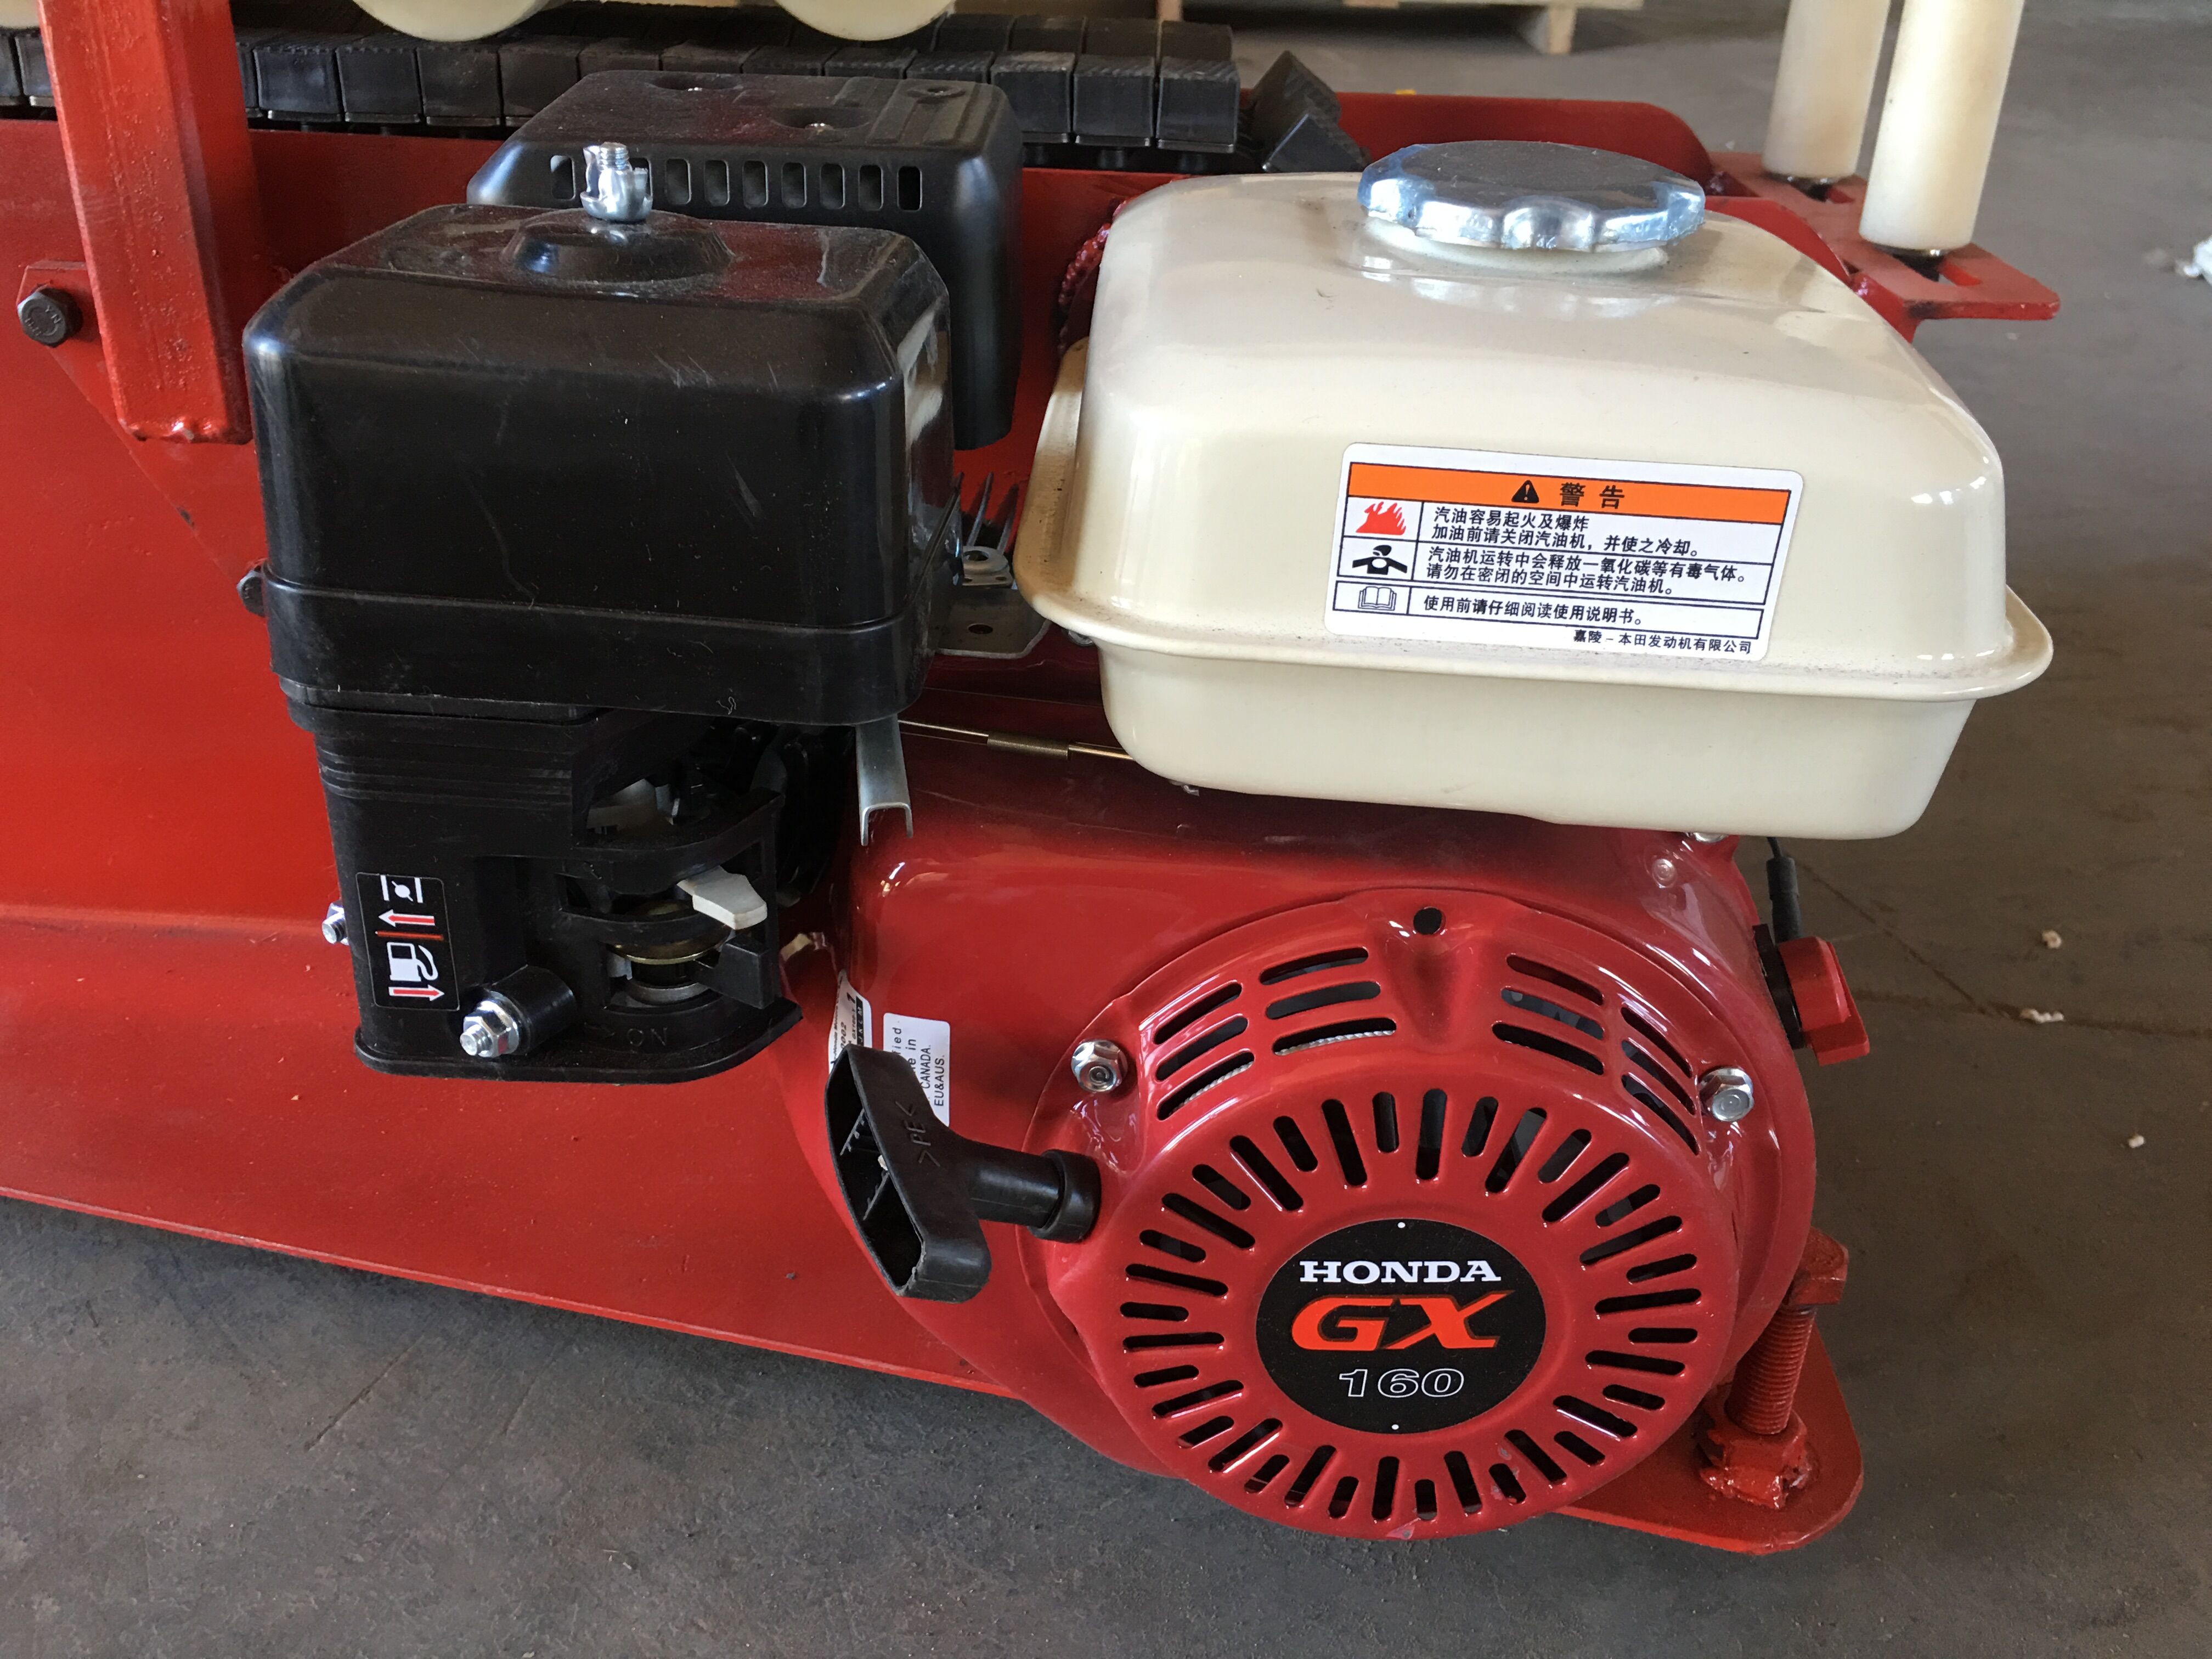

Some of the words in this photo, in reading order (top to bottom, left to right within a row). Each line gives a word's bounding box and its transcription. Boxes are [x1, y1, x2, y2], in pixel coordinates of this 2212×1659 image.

[1559, 482, 1625, 509] 警告
[1433, 506, 1590, 532] 汽油容易起火及爆炸
[1431, 523, 1697, 557] 加油前请关闭汽油机，并使之冷却。
[1426, 562, 1673, 595] 请勿在密闭的空间中运转汽油机。
[1427, 545, 1745, 583] 汽油机运转中会释放一氧化碳等有毒气体。
[1423, 595, 1641, 625] 使用前请仔细阅读使用说明书。
[905, 1038, 917, 1051] in
[1299, 1260, 1502, 1284] HONDA
[1291, 1290, 1515, 1351] GX
[1339, 1368, 1464, 1398] 160
